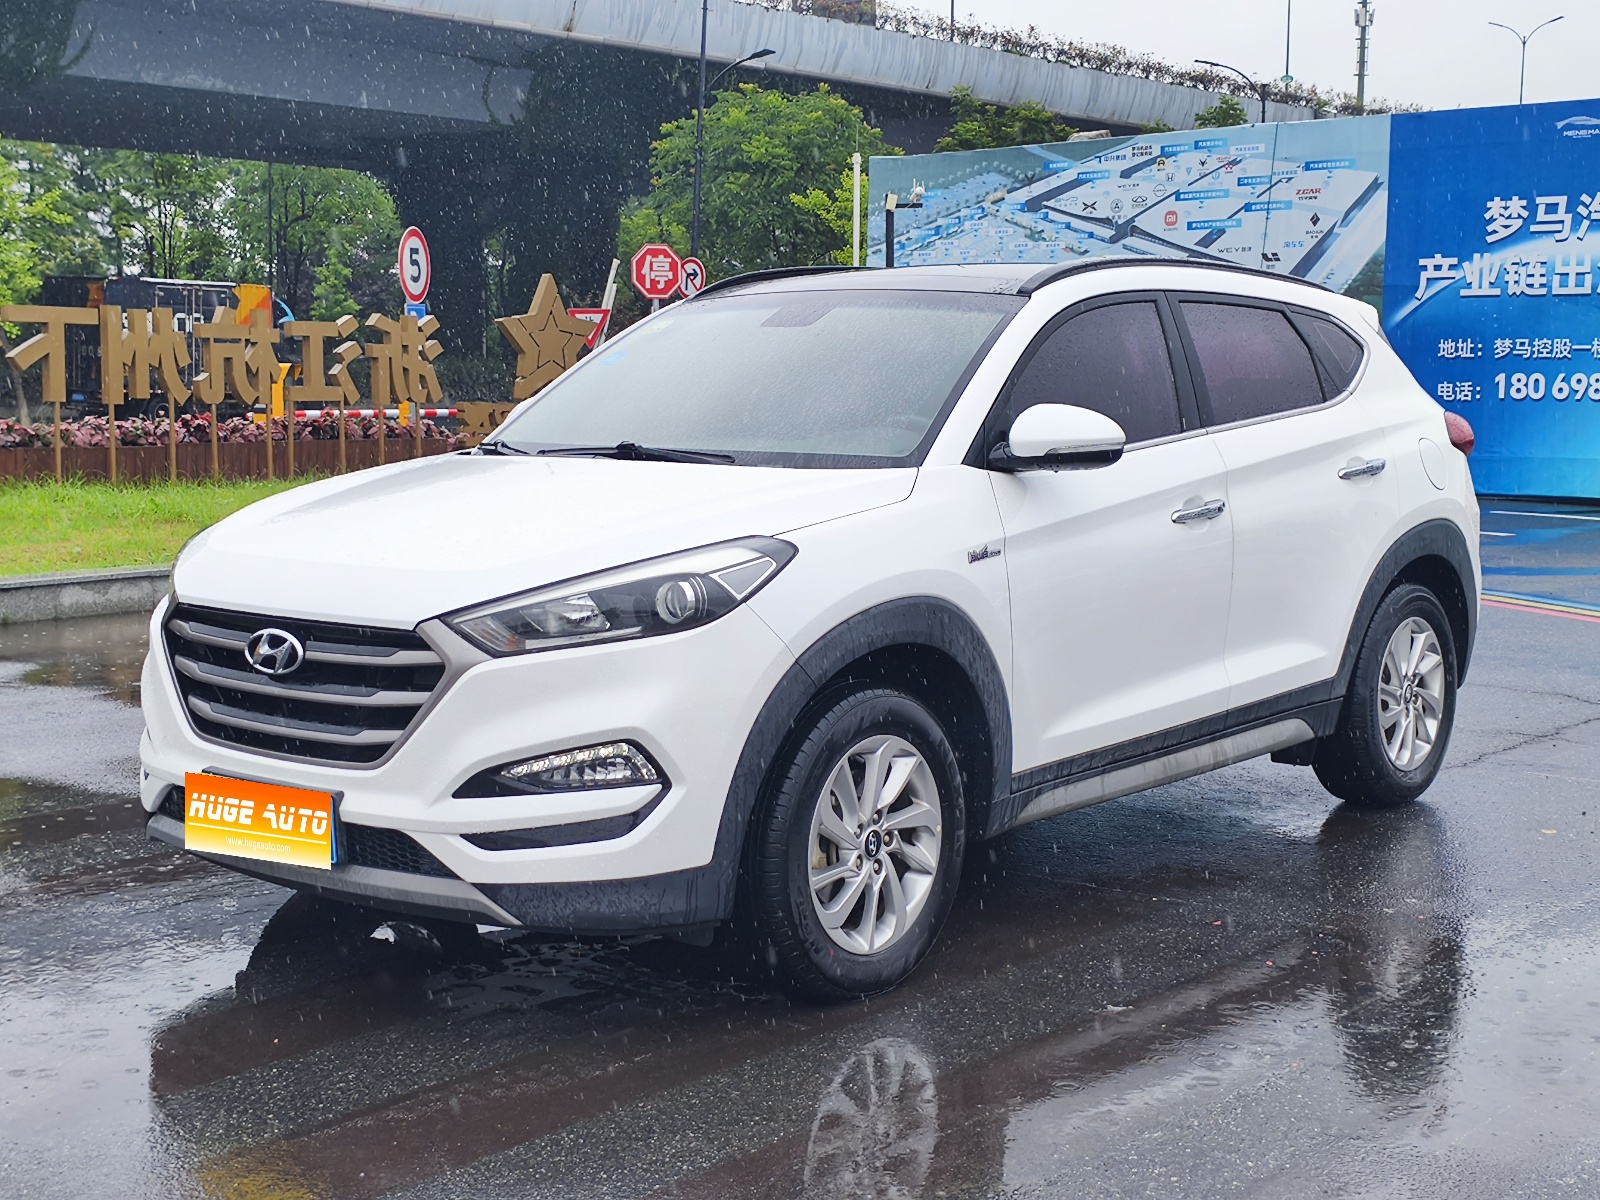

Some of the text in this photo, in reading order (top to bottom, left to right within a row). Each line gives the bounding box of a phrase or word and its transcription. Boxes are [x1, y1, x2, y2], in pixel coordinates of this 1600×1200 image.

[409, 247, 422, 283] 5
[641, 254, 674, 290] 停
[1414, 252, 1600, 300] 产业链出
[1437, 338, 1482, 359] 地址：
[1437, 381, 1481, 401] 电话：
[1494, 372, 1546, 400] 180
